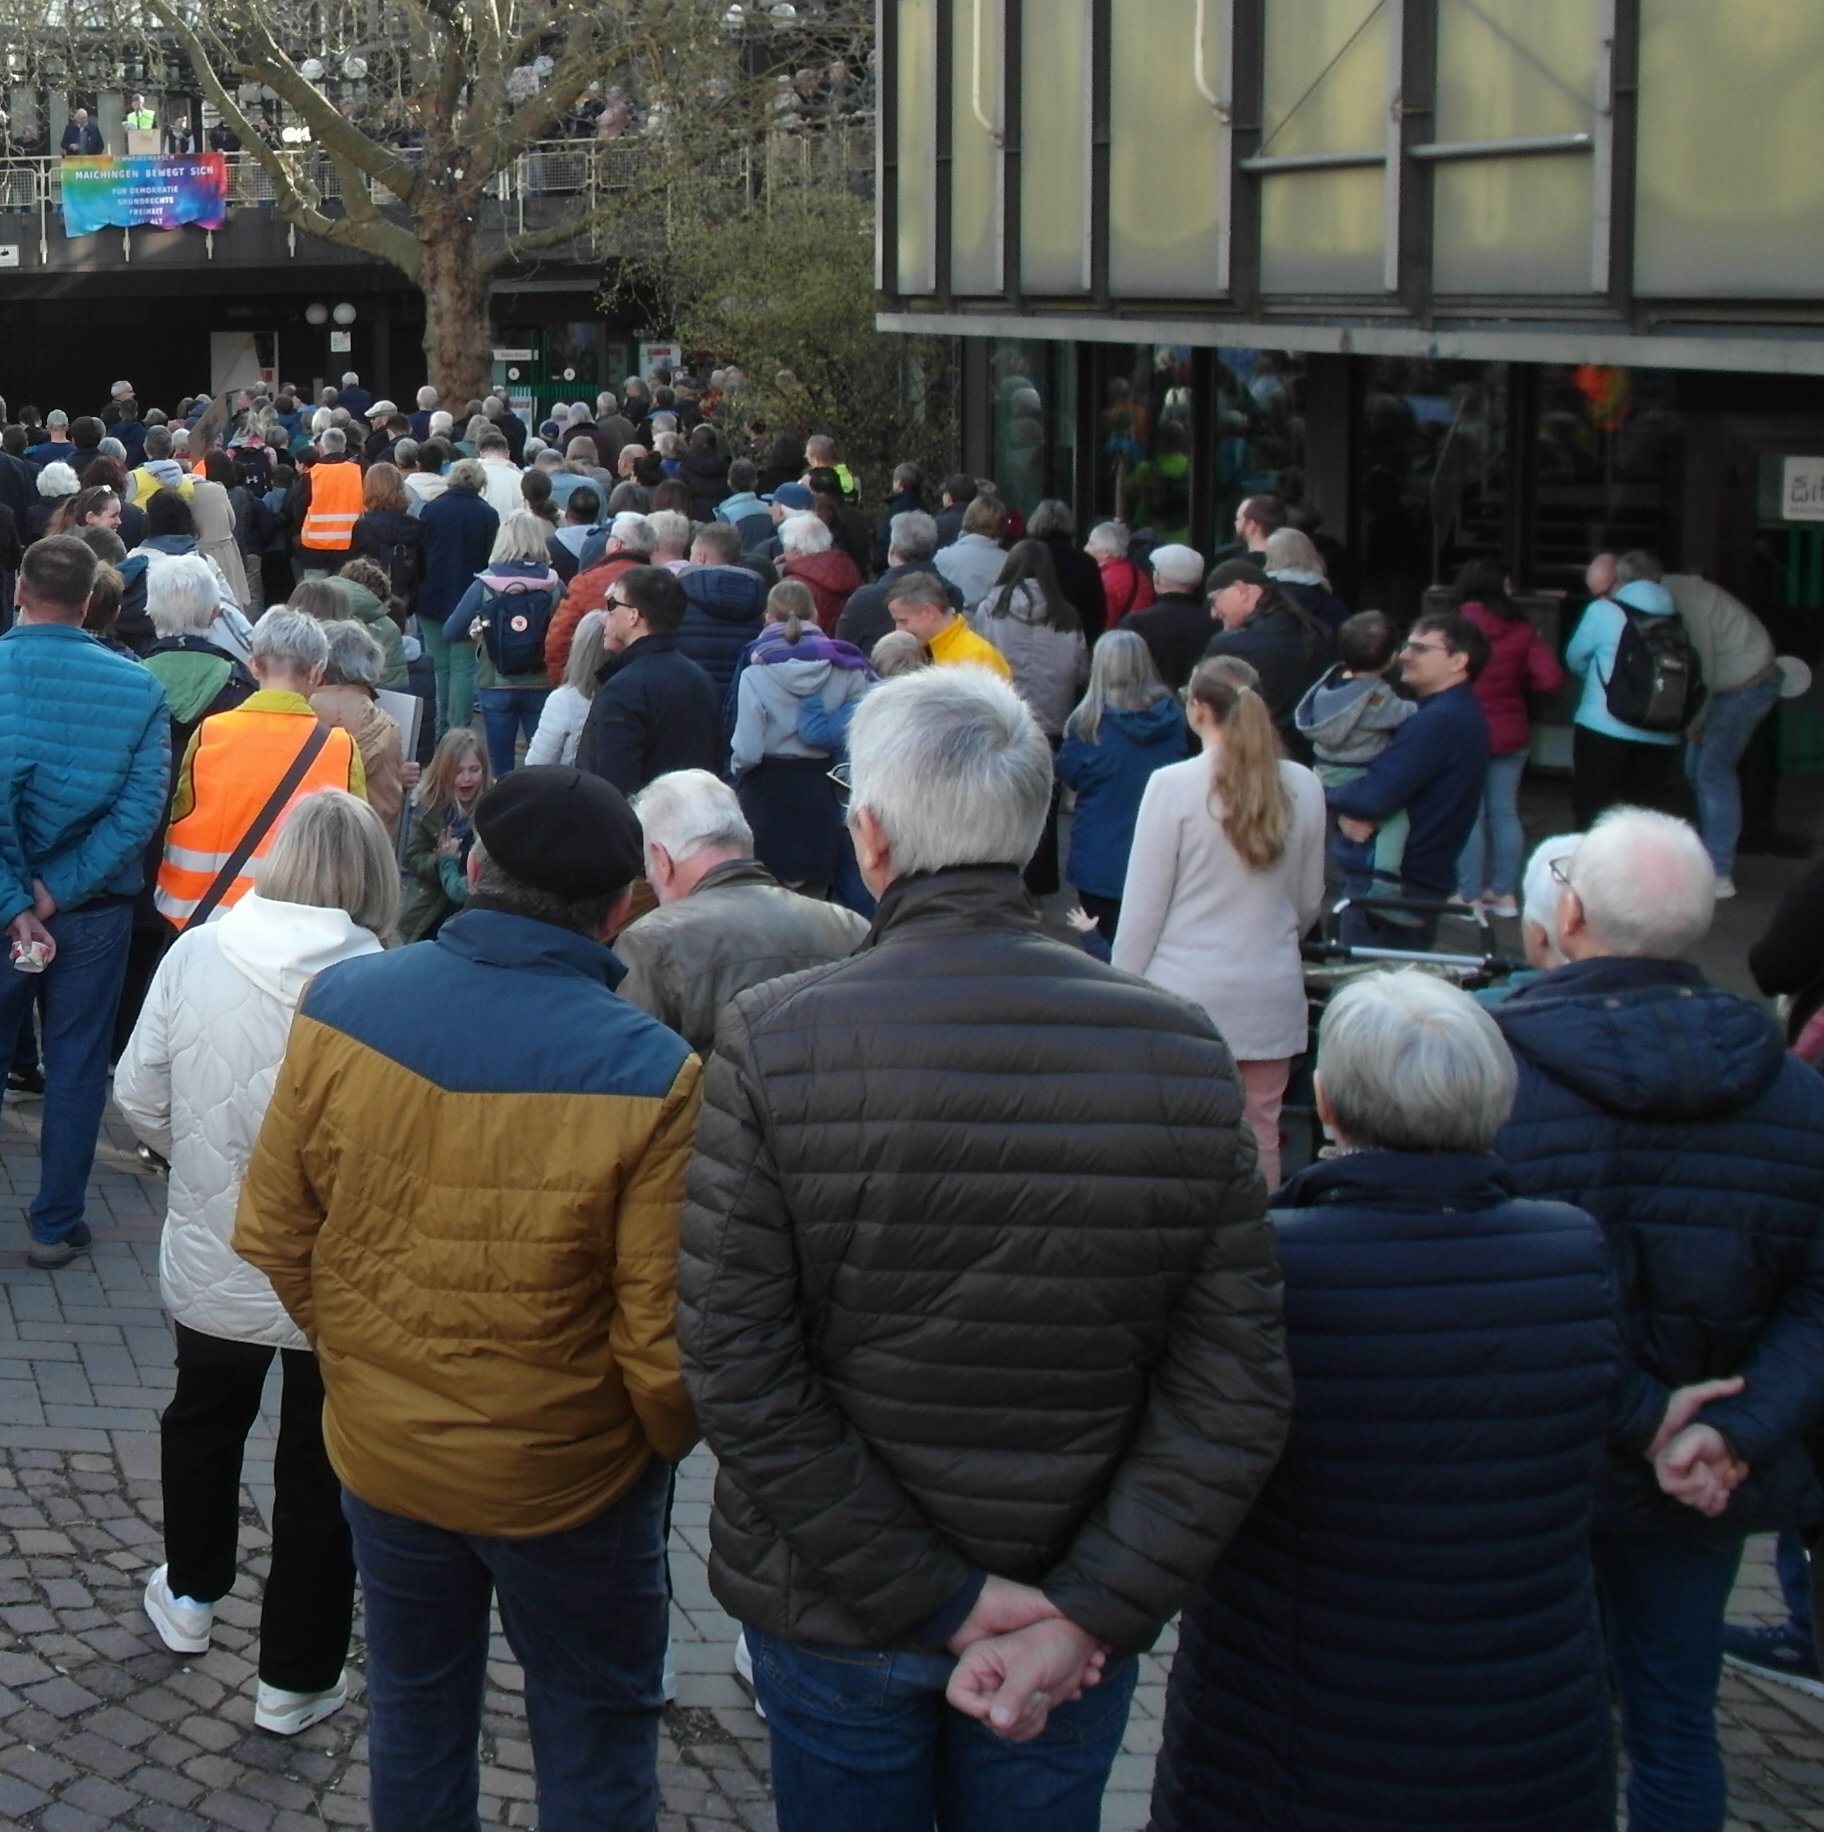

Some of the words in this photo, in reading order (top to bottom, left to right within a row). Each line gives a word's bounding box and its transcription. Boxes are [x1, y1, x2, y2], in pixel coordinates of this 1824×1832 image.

[75, 170, 139, 180] MAICHINGEN
[145, 168, 184, 178] BEWEGT
[190, 166, 213, 176] SICH
[112, 186, 127, 195] FÜR
[129, 185, 178, 195] DEMOKRATIE
[117, 196, 174, 205] GRUNDRECHTE
[129, 207, 163, 216] FREIHEIT
